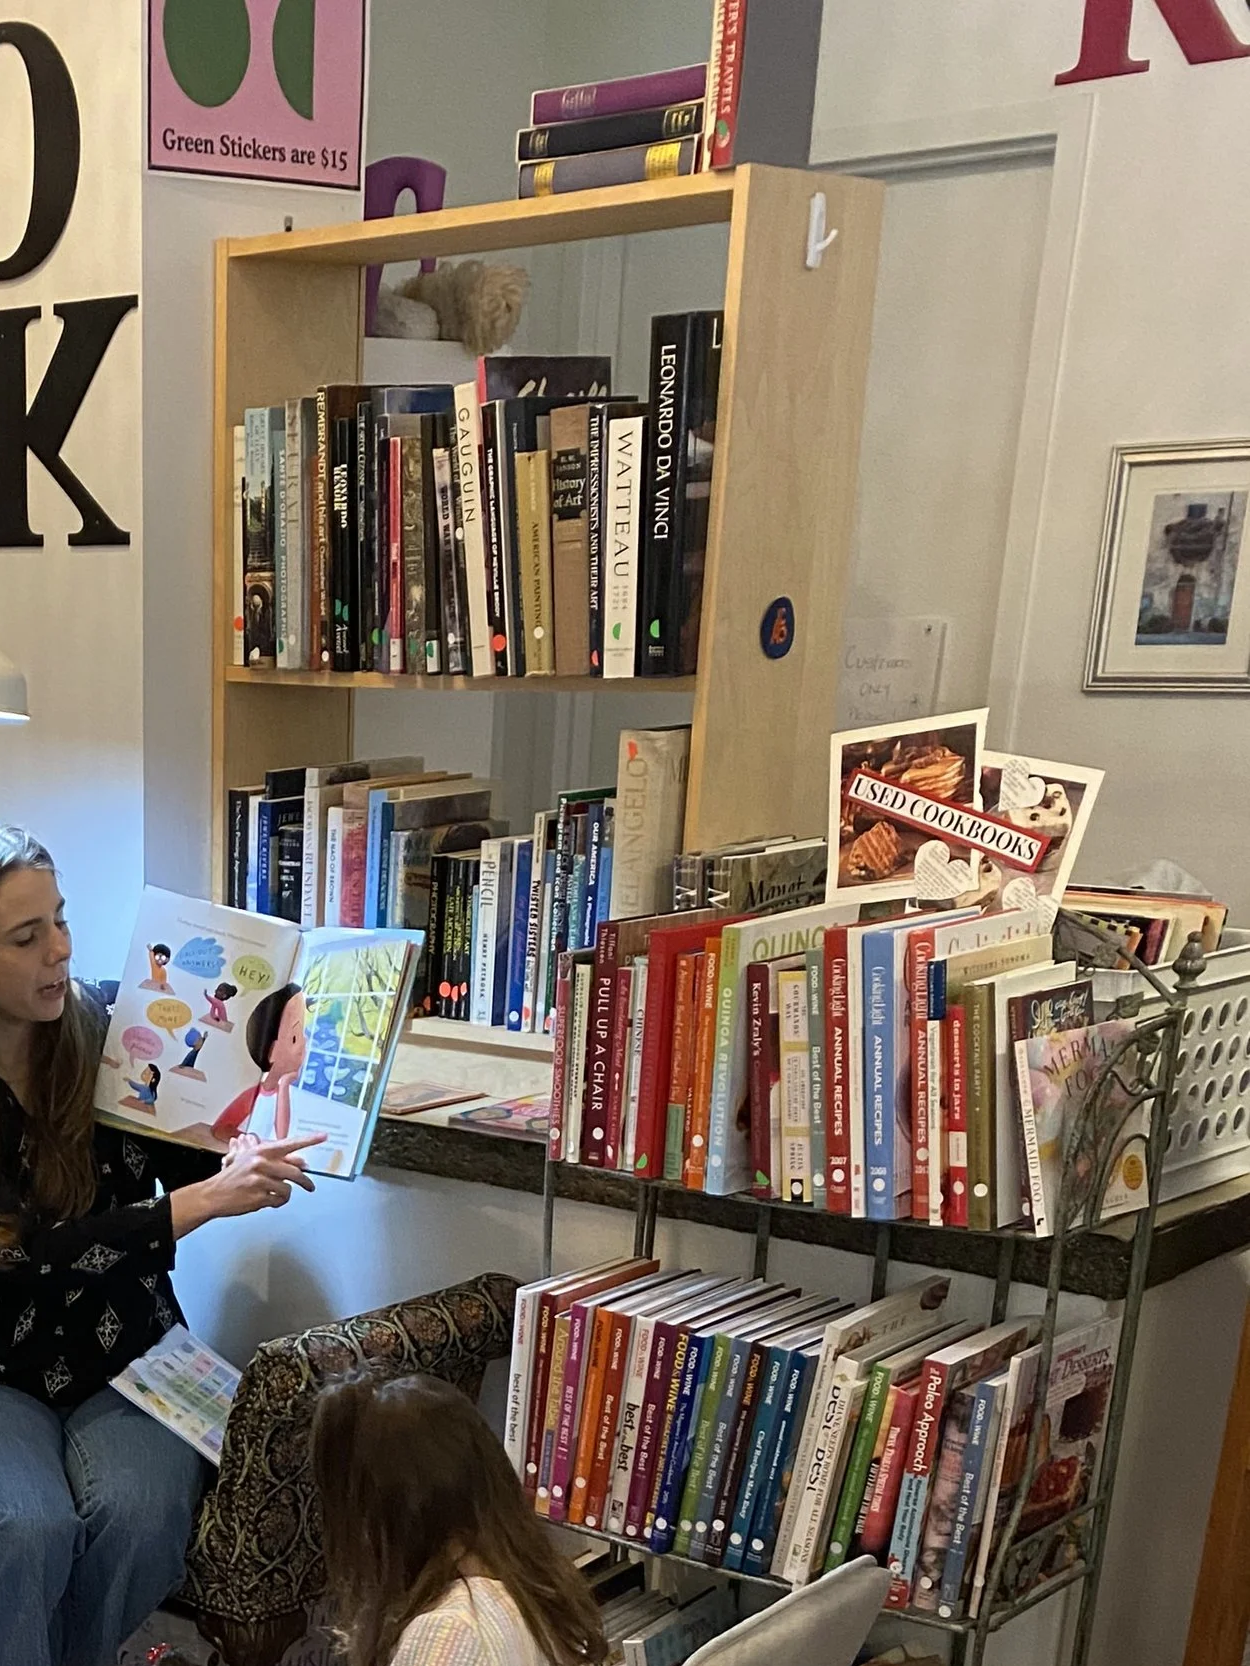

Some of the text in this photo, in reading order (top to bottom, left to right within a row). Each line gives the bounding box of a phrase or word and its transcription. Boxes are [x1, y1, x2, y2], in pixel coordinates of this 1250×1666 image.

[719, 40, 736, 115] TRAVELS
[163, 128, 348, 172] Green Stickers are $15
[279, 449, 287, 486] SANTE
[317, 391, 326, 481] REMBRANDT
[458, 407, 475, 523] GAUGUIN
[653, 344, 677, 540] LEONARDO DA VINCI
[553, 476, 586, 492] History
[565, 494, 584, 507] Art
[590, 439, 601, 528] IMPRESSIONISTS
[613, 430, 634, 578] WATTEAU
[532, 521, 542, 577] AMERICAN
[587, 822, 601, 886] OUR AMERICA
[853, 777, 1038, 861] USED COOKBOOKS
[480, 859, 497, 910] PENCIL
[238, 965, 271, 988] HEY!
[591, 977, 611, 1111] PULL UP A CHAIR
[751, 982, 762, 1058] Kevin Zraly's
[953, 1020, 961, 1072] desserts
[552, 1005, 566, 1125] SUPERFOOD SMOOTHIES
[713, 987, 733, 1147] QUINOA REVOLUTION
[811, 1046, 820, 1072] Best
[833, 1026, 843, 1136] ANNUAL RECIPES
[873, 1036, 883, 1146] ANNUAL RECIPES
[917, 1029, 926, 1143] ANNUAL RECIPES
[829, 1157, 847, 1166] 2007
[1024, 1108, 1038, 1167] MERMAID
[913, 1375, 942, 1472] Paleo Approach
